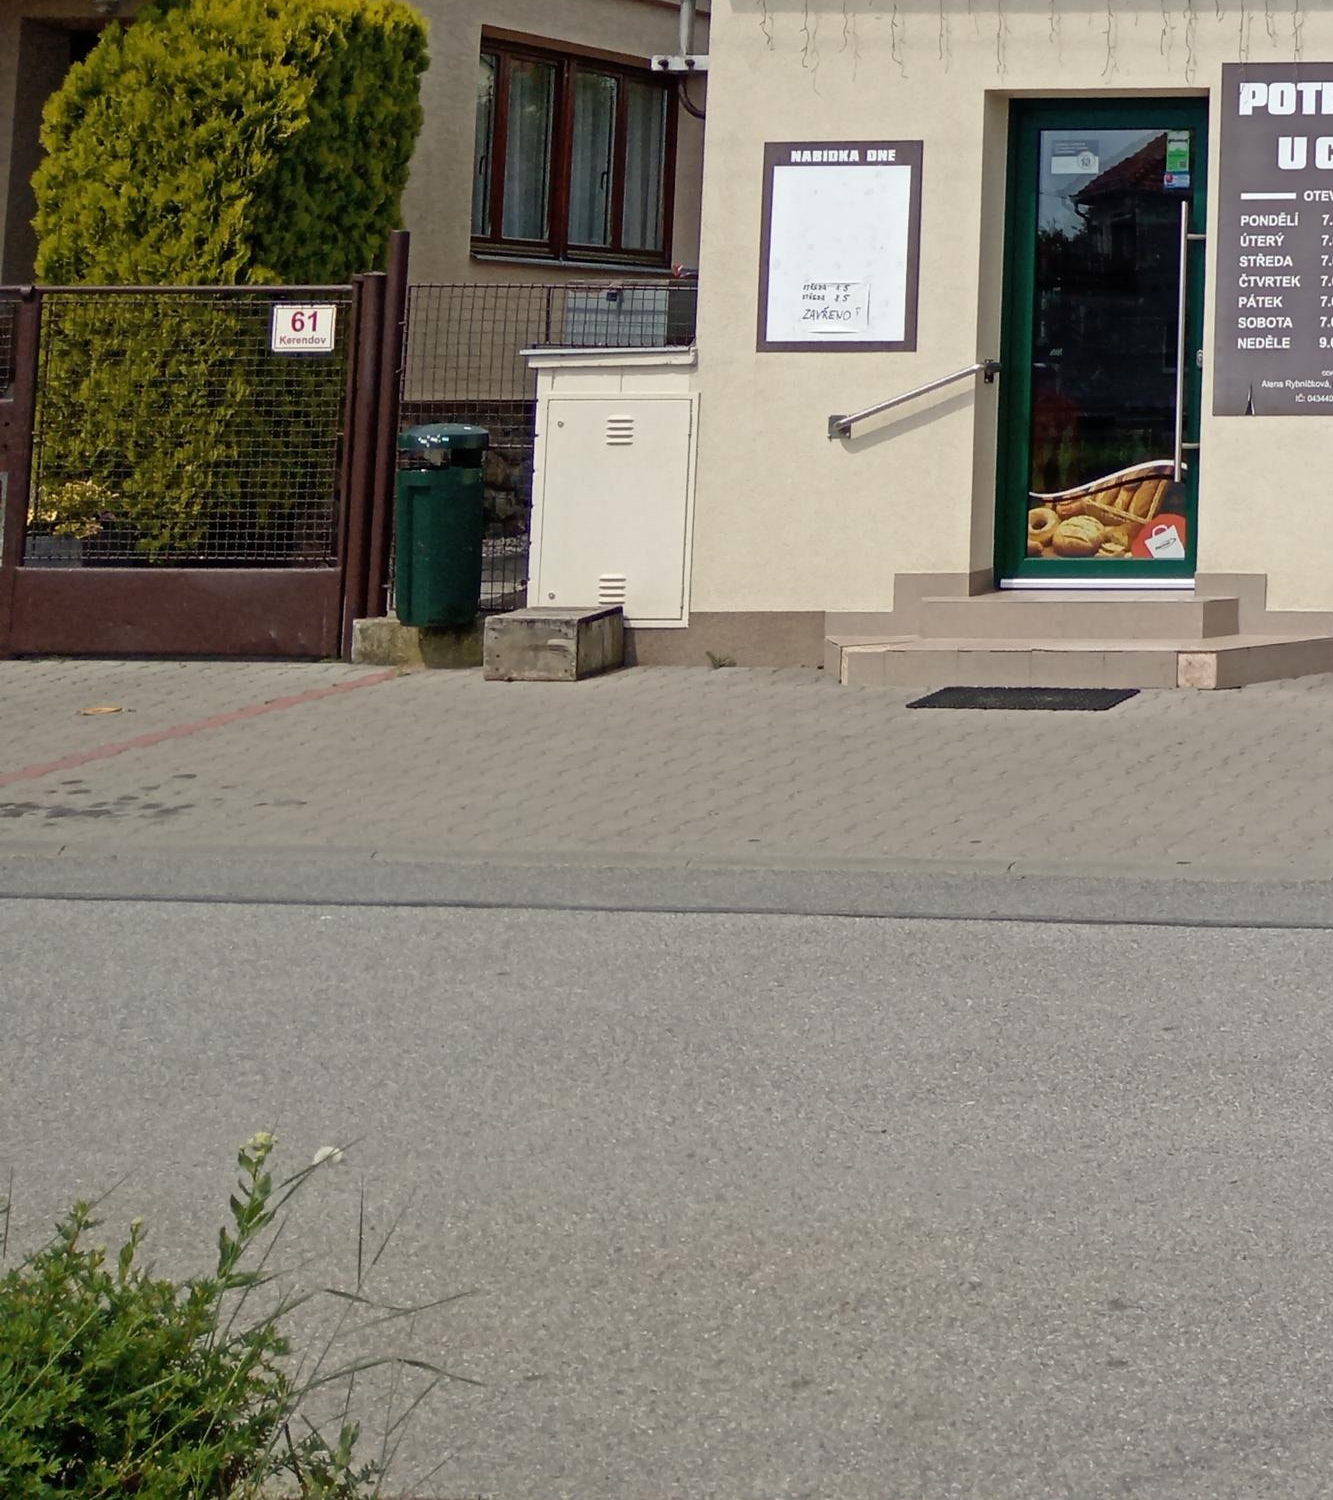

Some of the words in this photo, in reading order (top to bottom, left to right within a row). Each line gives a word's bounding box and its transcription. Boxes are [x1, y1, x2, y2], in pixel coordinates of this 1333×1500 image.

[866, 149, 897, 162] DNE
[1277, 136, 1308, 170] U
[1240, 211, 1299, 227] PONDĚLÍ
[1239, 232, 1285, 248] ÚTERÝ
[1239, 252, 1294, 268] STŘEDA
[1238, 274, 1301, 288] ČTVRTEK
[1238, 294, 1283, 309] PÁTEK
[291, 310, 318, 332] 61
[1237, 316, 1294, 329] SOBOTA
[279, 335, 327, 345] Kerendov
[1237, 334, 1291, 350] NEDĚLE
[1261, 379, 1284, 388] Alena
